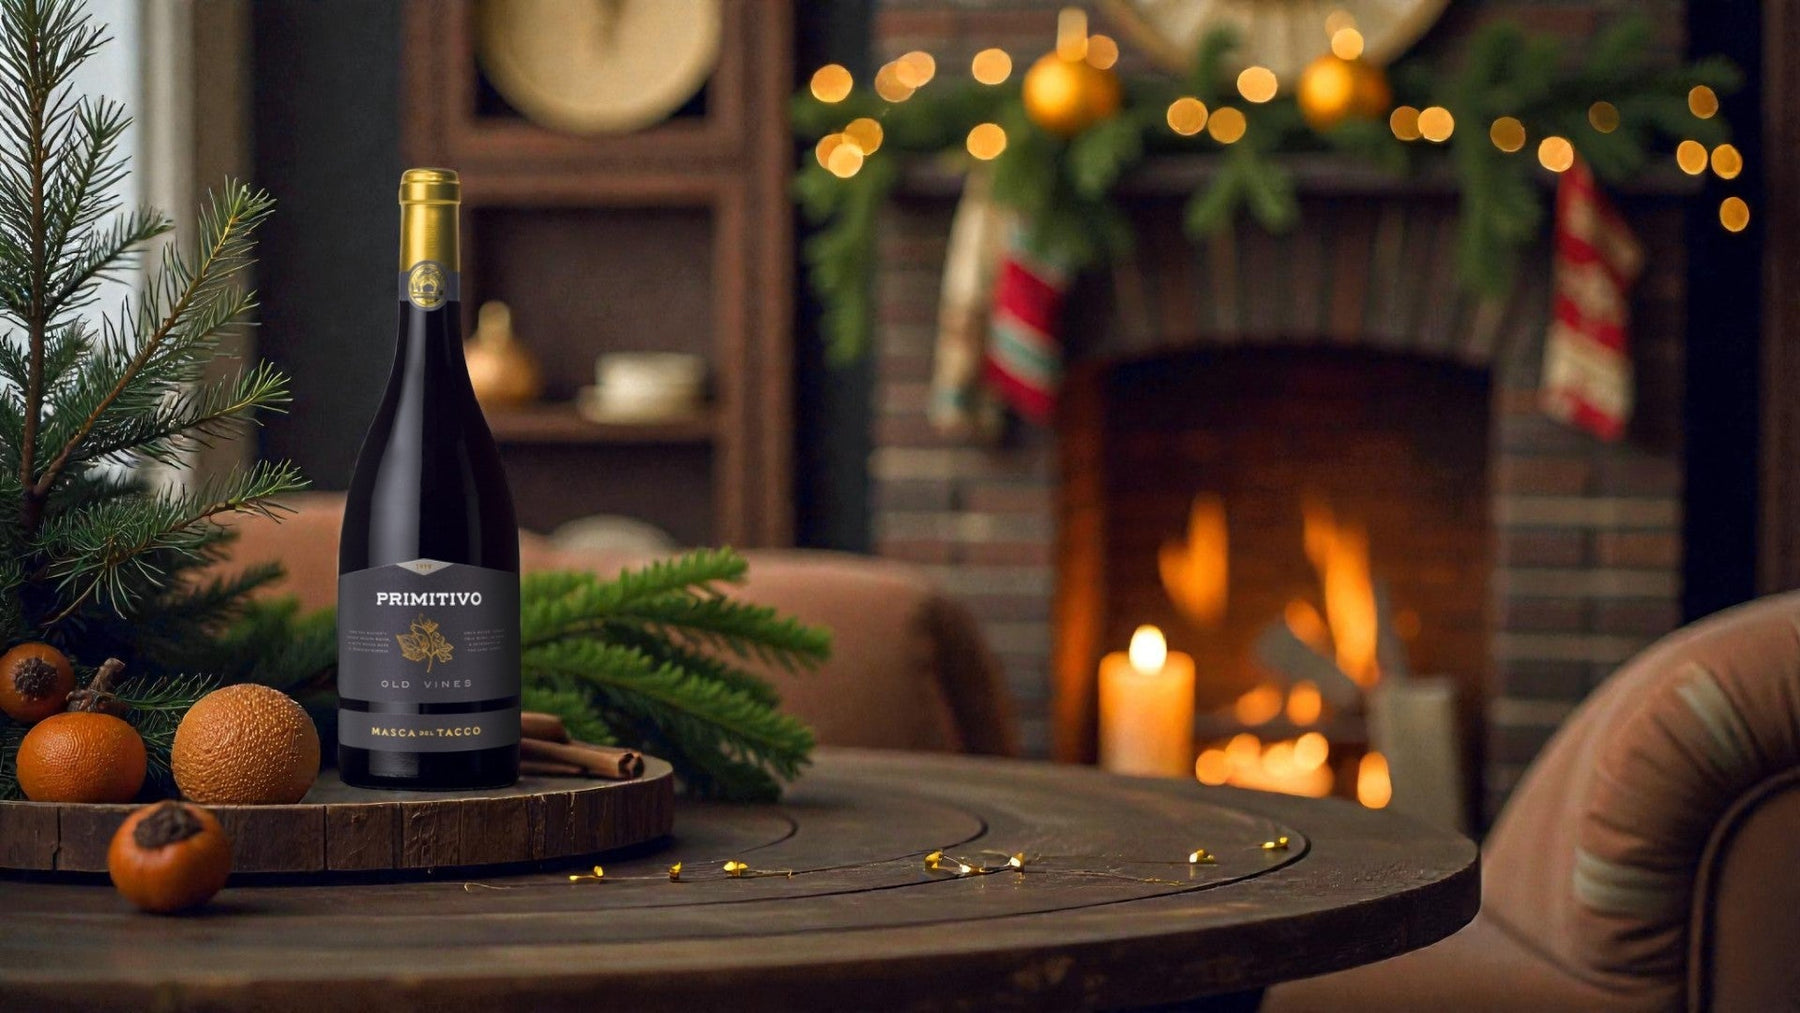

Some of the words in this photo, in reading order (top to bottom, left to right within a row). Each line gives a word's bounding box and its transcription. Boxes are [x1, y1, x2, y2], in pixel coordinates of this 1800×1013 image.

[376, 592, 482, 606] PRIMITIVO
[381, 680, 410, 689] OLD
[424, 679, 472, 689] VINES
[371, 726, 416, 738] MASCA
[436, 726, 482, 738] TACCO
